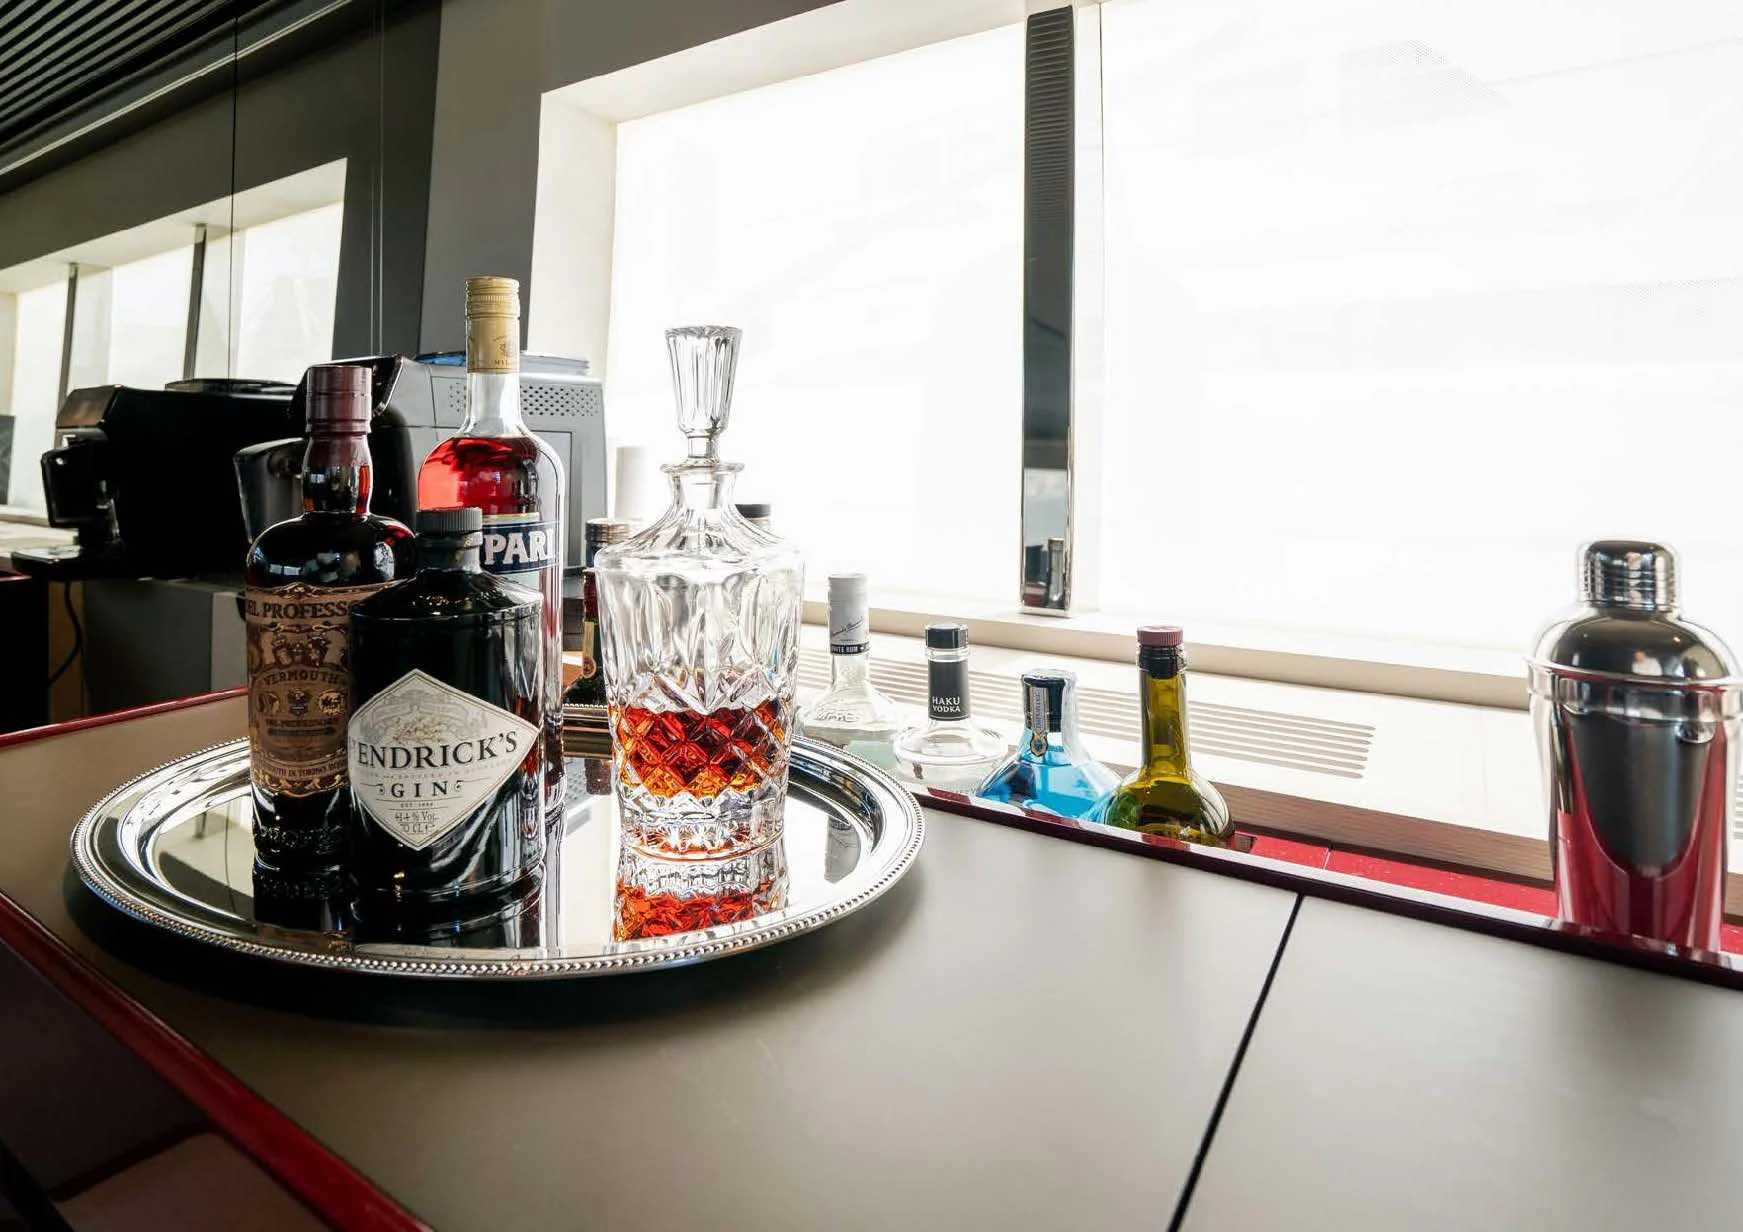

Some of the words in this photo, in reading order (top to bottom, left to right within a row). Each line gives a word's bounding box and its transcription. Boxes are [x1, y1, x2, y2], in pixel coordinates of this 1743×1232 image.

[483, 528, 554, 565] PARI
[247, 599, 260, 617] EL
[263, 601, 350, 619] PROFESS
[932, 696, 960, 705] HAKU
[932, 705, 961, 713] VODKA
[355, 731, 518, 769] ENDRICK'S
[391, 781, 448, 798] GIN
